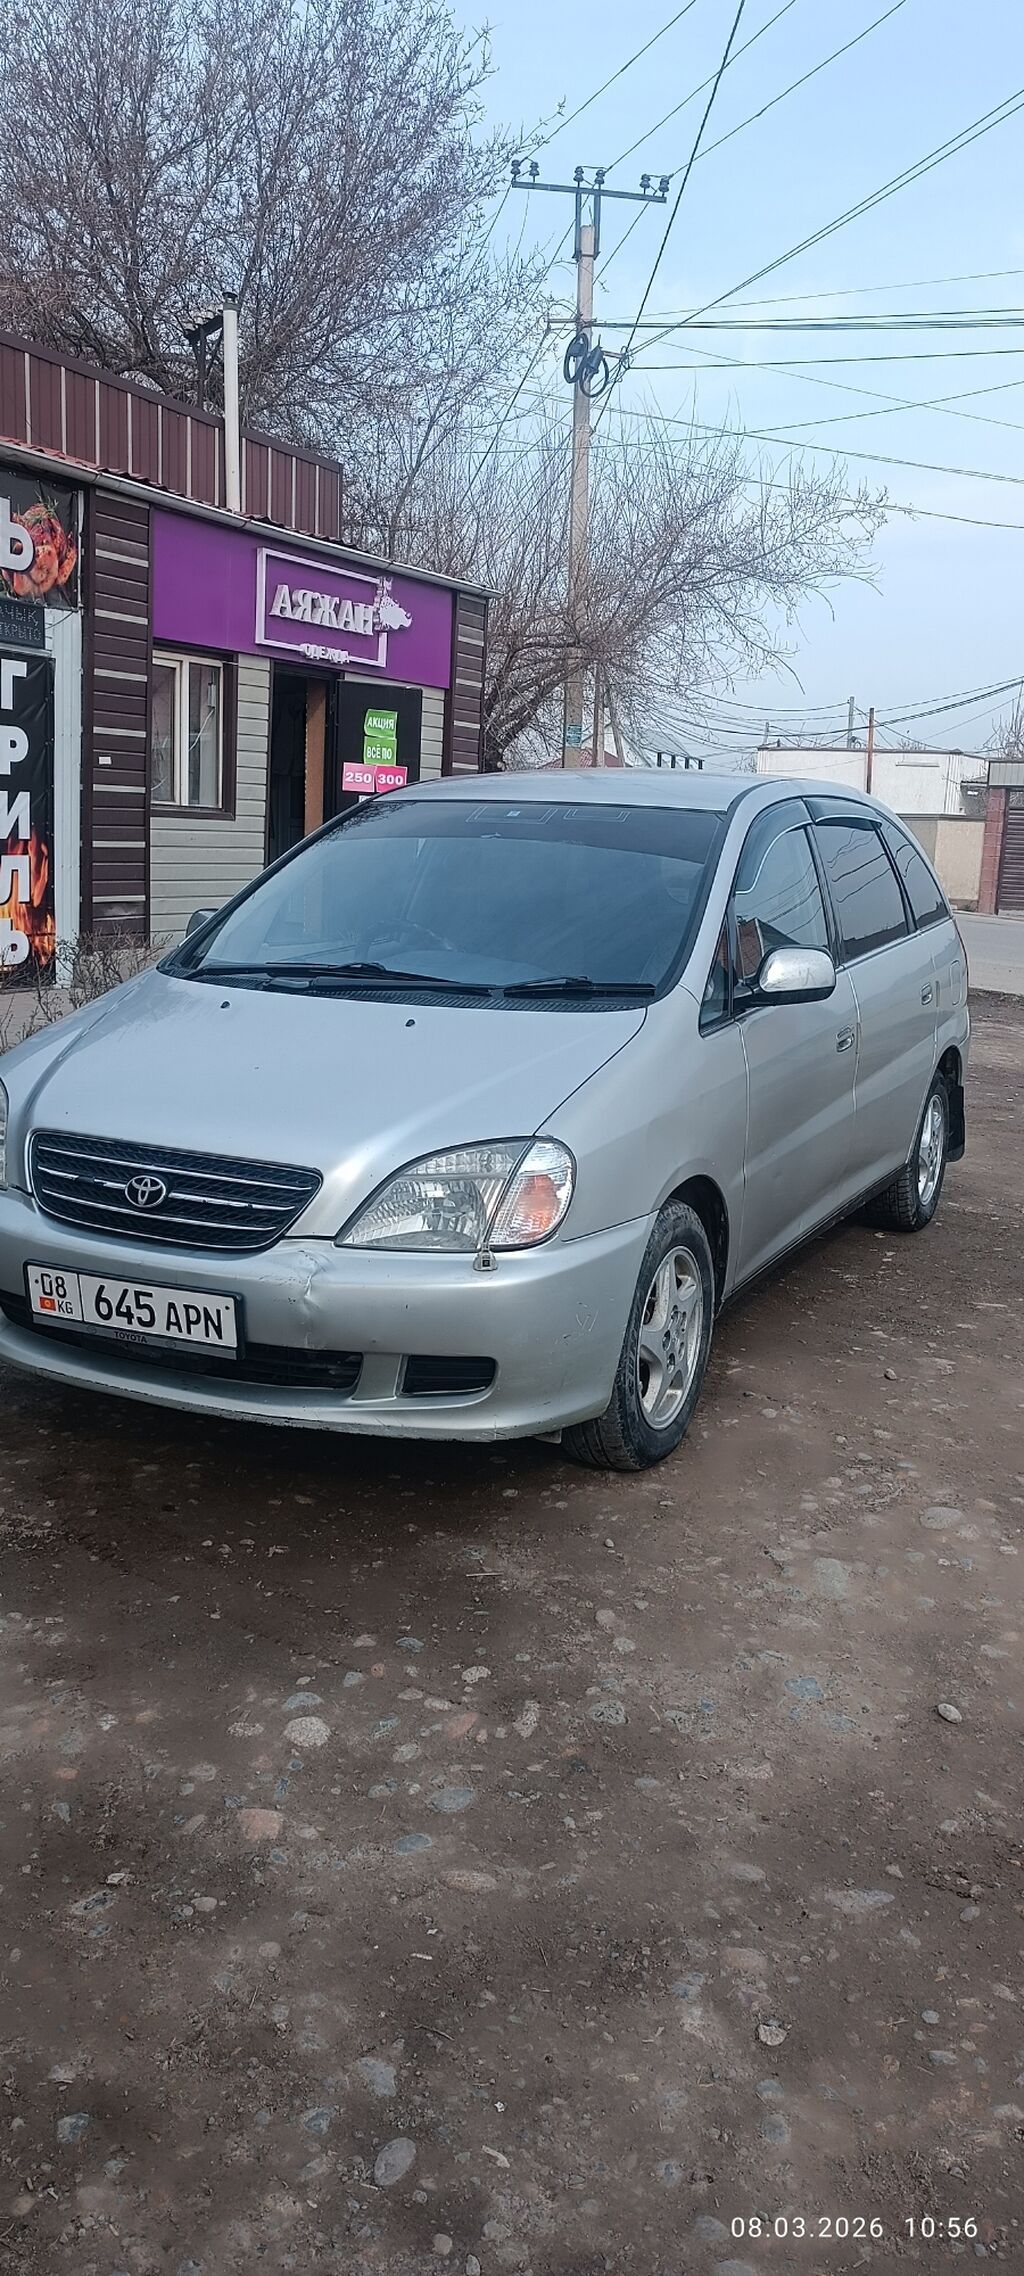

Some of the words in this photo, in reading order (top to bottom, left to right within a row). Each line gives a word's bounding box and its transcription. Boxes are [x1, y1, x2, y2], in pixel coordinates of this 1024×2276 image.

[269, 585, 374, 636] АЯЖАН
[301, 643, 350, 665] ОДЕЖДА
[367, 717, 395, 730] АКЦИЯ
[381, 747, 393, 760] ПО
[345, 772, 372, 783] 250
[378, 774, 404, 785] 300
[40, 1273, 67, 1299] 08
[94, 1284, 156, 1328] 645
[165, 1301, 224, 1340] APN
[57, 1299, 74, 1315] KG
[114, 1331, 148, 1344] TOYOTA
